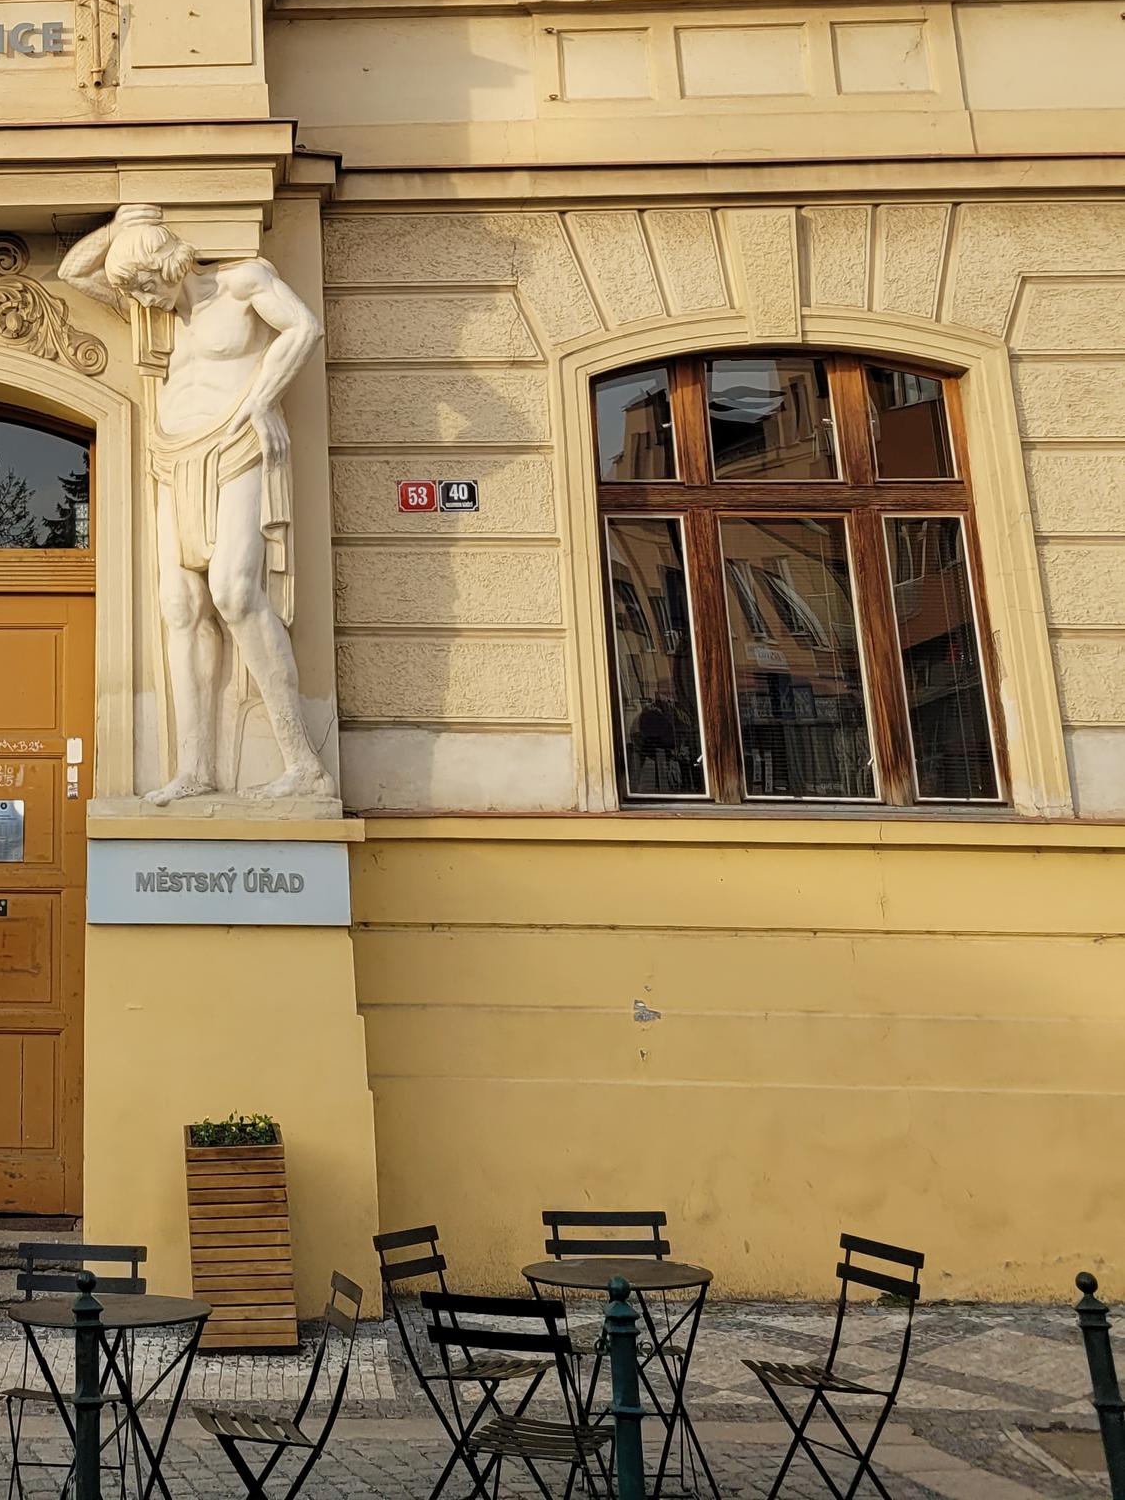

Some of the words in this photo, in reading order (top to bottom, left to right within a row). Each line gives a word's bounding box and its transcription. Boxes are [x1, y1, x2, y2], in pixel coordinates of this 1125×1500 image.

[408, 486, 428, 506] 53
[449, 483, 468, 500] 40
[135, 866, 237, 893] MĚSTSKÝ
[243, 867, 304, 893] ÚŘAD
